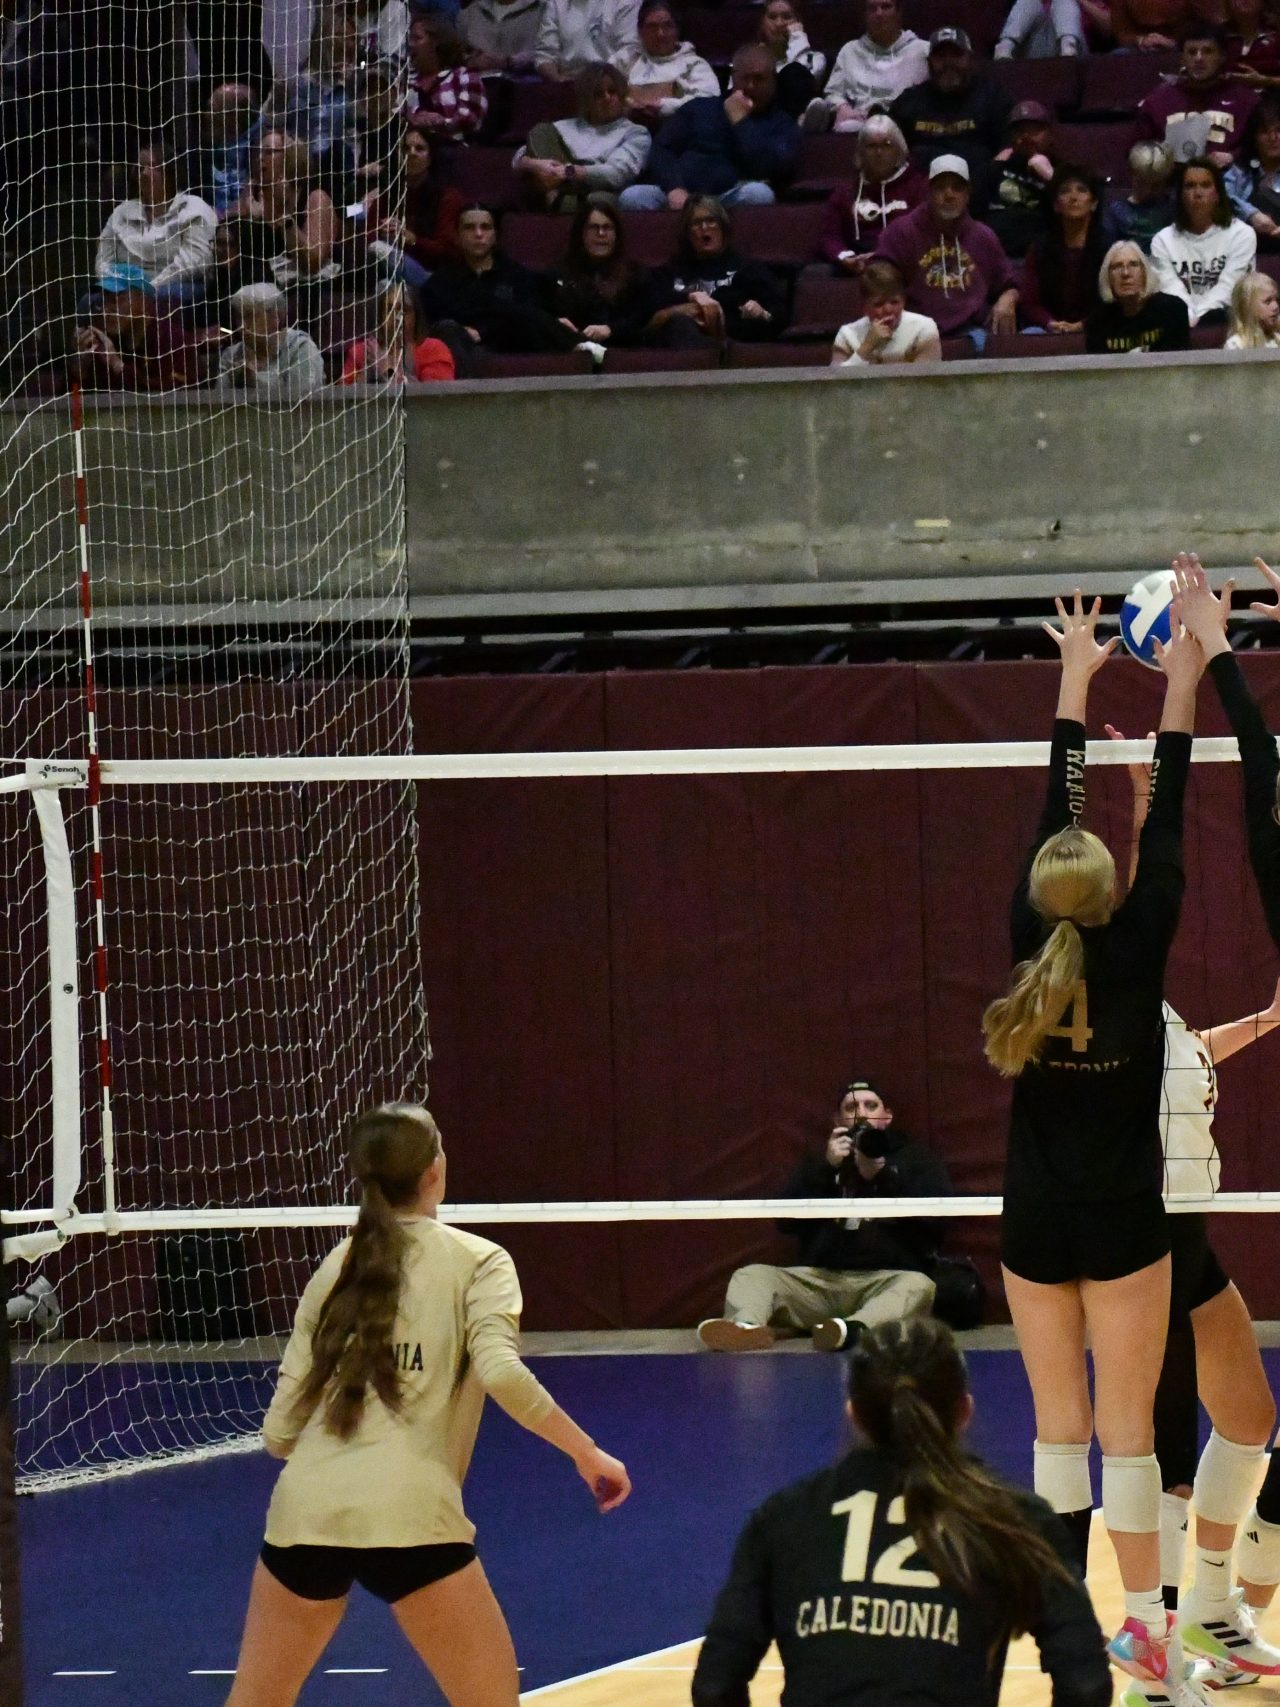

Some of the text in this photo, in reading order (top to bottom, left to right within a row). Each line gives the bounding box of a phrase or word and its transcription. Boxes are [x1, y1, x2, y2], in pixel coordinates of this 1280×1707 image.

[1170, 254, 1228, 276] AGES
[52, 765, 81, 773] Senoh
[1045, 978, 1095, 1054] 4
[831, 1489, 942, 1590] 12
[796, 1594, 960, 1648] CALEDONIA
